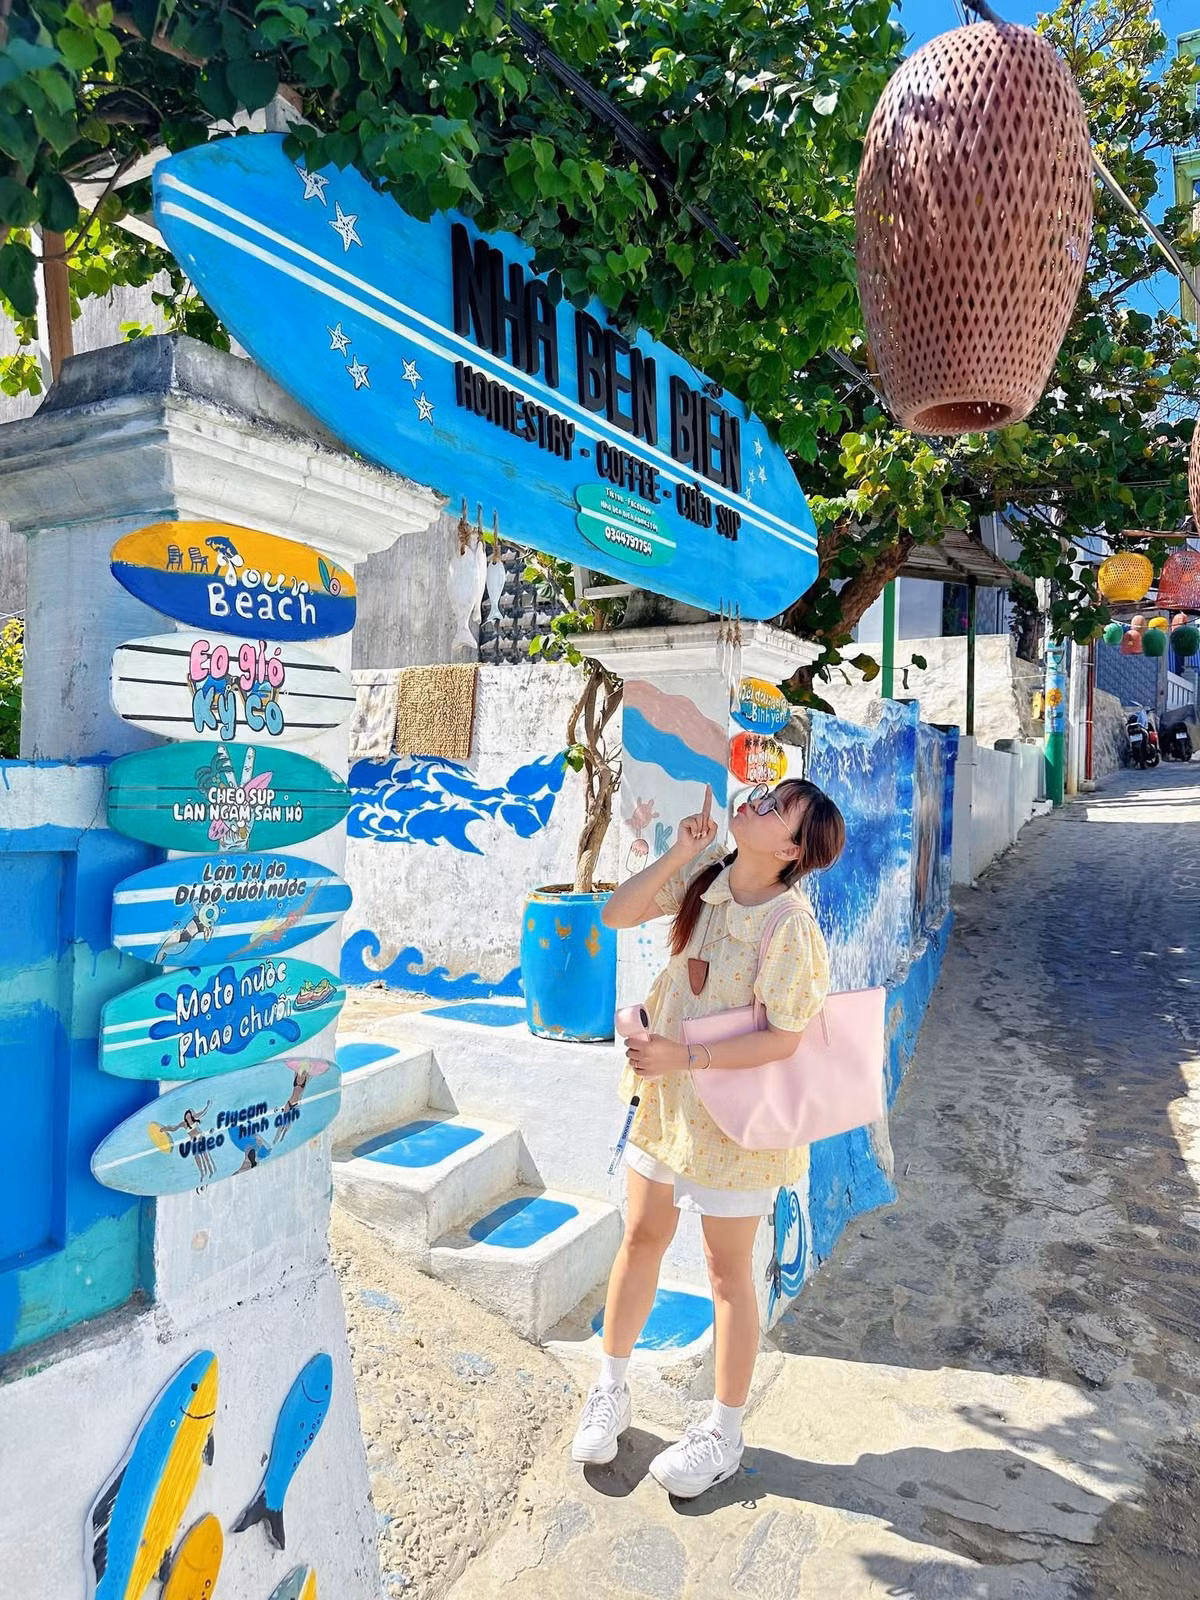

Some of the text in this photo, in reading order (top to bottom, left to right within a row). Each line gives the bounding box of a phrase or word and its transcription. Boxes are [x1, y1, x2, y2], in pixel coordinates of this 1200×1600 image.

[455, 360, 576, 461] HOMESTAY
[596, 439, 662, 505] COFFEE
[716, 503, 742, 542] SUP
[217, 554, 311, 597] Tour
[207, 582, 316, 625] Beach
[248, 787, 275, 807] SUP
[255, 805, 282, 822] SAN
[265, 859, 287, 881] do
[176, 975, 235, 1026] Moto
[178, 1024, 233, 1069] Phao
[216, 1100, 268, 1129] Flycam
[179, 1132, 225, 1159] Video
